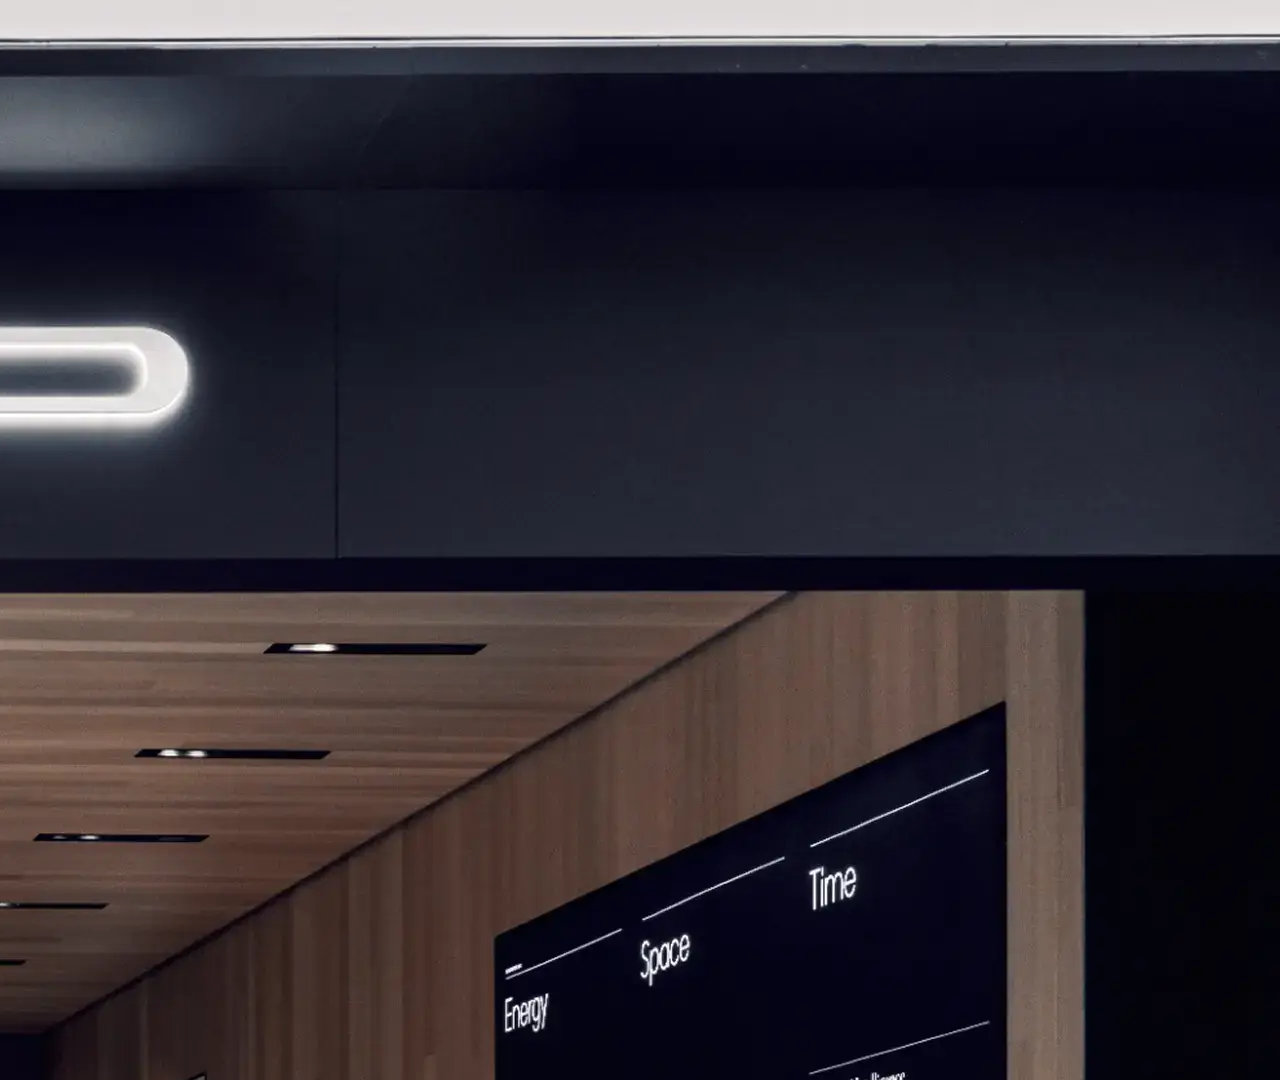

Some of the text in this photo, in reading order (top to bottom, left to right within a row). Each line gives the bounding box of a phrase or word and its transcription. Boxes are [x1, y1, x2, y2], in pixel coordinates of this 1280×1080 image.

[809, 866, 857, 911] Time
[640, 934, 690, 987] Space
[505, 993, 549, 1033] Energy
